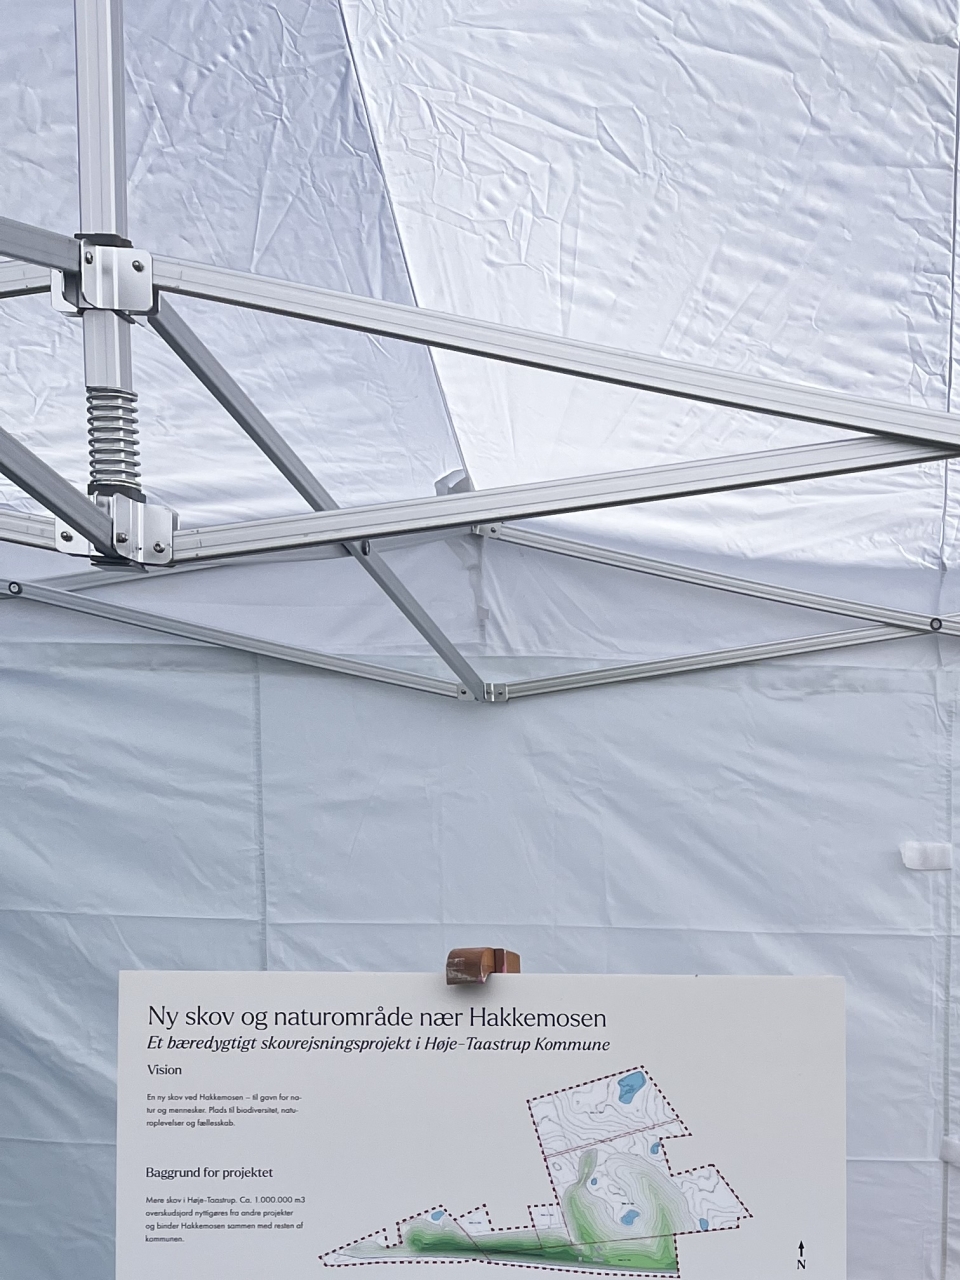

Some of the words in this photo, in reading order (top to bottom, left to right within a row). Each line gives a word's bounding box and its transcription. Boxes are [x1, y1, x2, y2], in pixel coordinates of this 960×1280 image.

[148, 1004, 179, 1031] Ny
[185, 1004, 235, 1026] skov
[240, 1010, 268, 1031] og
[274, 1005, 413, 1027] naturområde
[419, 1011, 464, 1027] nær
[469, 1006, 606, 1028] Hakkemosen
[146, 1034, 164, 1050] Et
[166, 1034, 258, 1053] bæredygtigt
[260, 1035, 412, 1054] skovrejsningsprojekt
[424, 1036, 531, 1054] Høje-Taastrup
[533, 1036, 611, 1051] Kommune
[146, 1063, 182, 1075] Vision
[146, 1092, 156, 1101] En
[156, 1094, 166, 1103] ny
[167, 1092, 184, 1101] skov
[184, 1092, 198, 1101] ved
[198, 1092, 244, 1101] Hakkemosen
[251, 1092, 259, 1101] til
[259, 1095, 278, 1103] gavn
[278, 1092, 289, 1101] for
[156, 1107, 167, 1116] og
[168, 1105, 207, 1114] mennesker.
[208, 1105, 228, 1114] Plads
[235, 1105, 280, 1115] biodiversitet,
[185, 1120, 196, 1129] og
[196, 1117, 236, 1127] fællesskab.
[145, 1166, 201, 1181] Baggrund
[203, 1166, 220, 1178] for
[222, 1166, 273, 1181] projektet
[145, 1196, 165, 1204] Mere
[165, 1195, 182, 1204] skov
[186, 1195, 238, 1206] Høje-Taastrup.
[238, 1195, 252, 1204] Ca.
[254, 1195, 293, 1204] 1.000.000
[293, 1195, 306, 1204] m3
[144, 1208, 194, 1219] overskudsjord
[194, 1209, 229, 1219] nyttigøres
[229, 1208, 240, 1217] fra
[240, 1208, 262, 1217] andre
[262, 1208, 294, 1218] projekter
[144, 1223, 155, 1232] og
[156, 1220, 180, 1230] binder
[180, 1220, 226, 1230] Hakkemosen
[256, 1220, 273, 1230] med
[273, 1222, 295, 1230] resten
[295, 1220, 304, 1230] af
[144, 1234, 185, 1243] kommunen.
[796, 1258, 806, 1270] N
